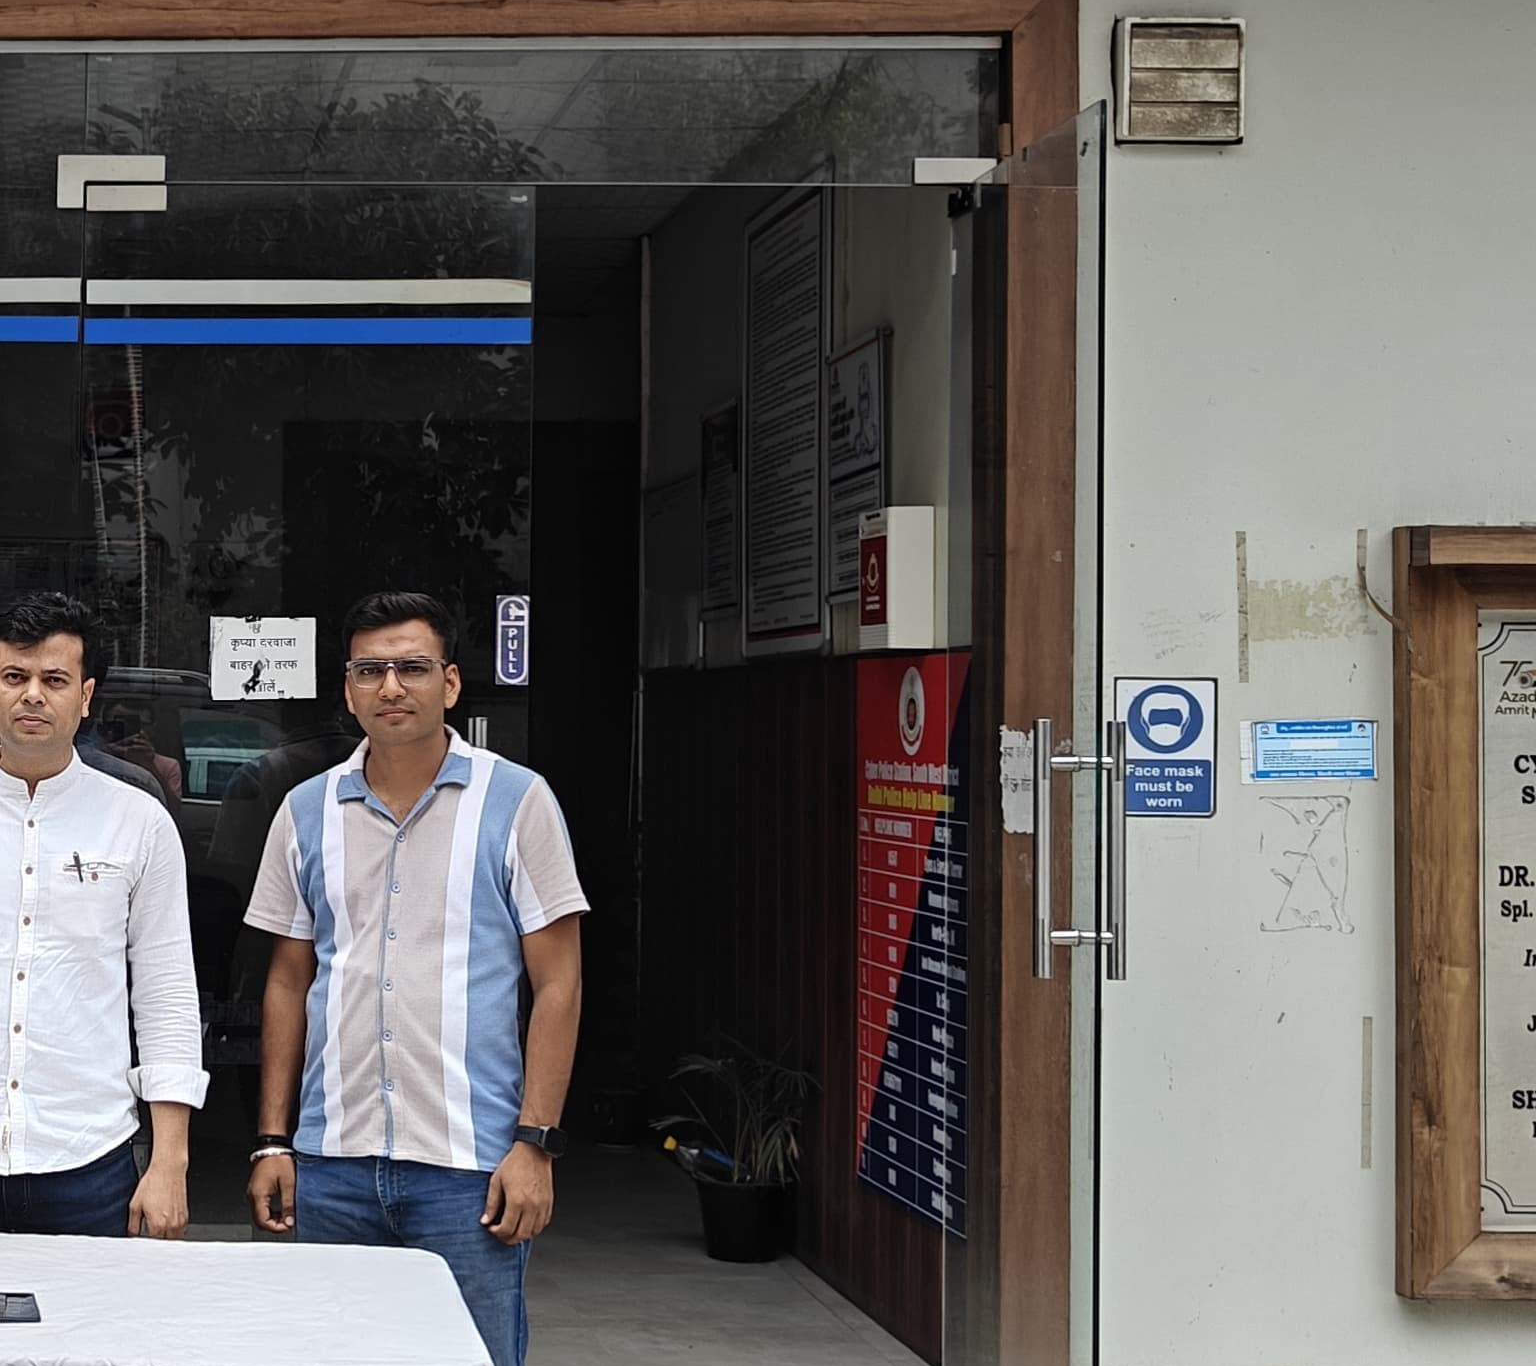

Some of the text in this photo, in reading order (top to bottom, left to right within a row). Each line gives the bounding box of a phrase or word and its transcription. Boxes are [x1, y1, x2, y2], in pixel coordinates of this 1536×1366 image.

[260, 638, 296, 647] दरवाजा
[507, 627, 518, 674] PULL
[229, 660, 253, 670] बाहर
[274, 660, 298, 669] तरफ
[1499, 690, 1536, 703] Azad
[1494, 705, 1530, 715] Amrit
[1125, 765, 1204, 777] Face mask
[1135, 780, 1194, 792] must be
[1145, 797, 1182, 807] worn
[1498, 865, 1535, 887] DR.
[1500, 899, 1533, 923] Spl.
